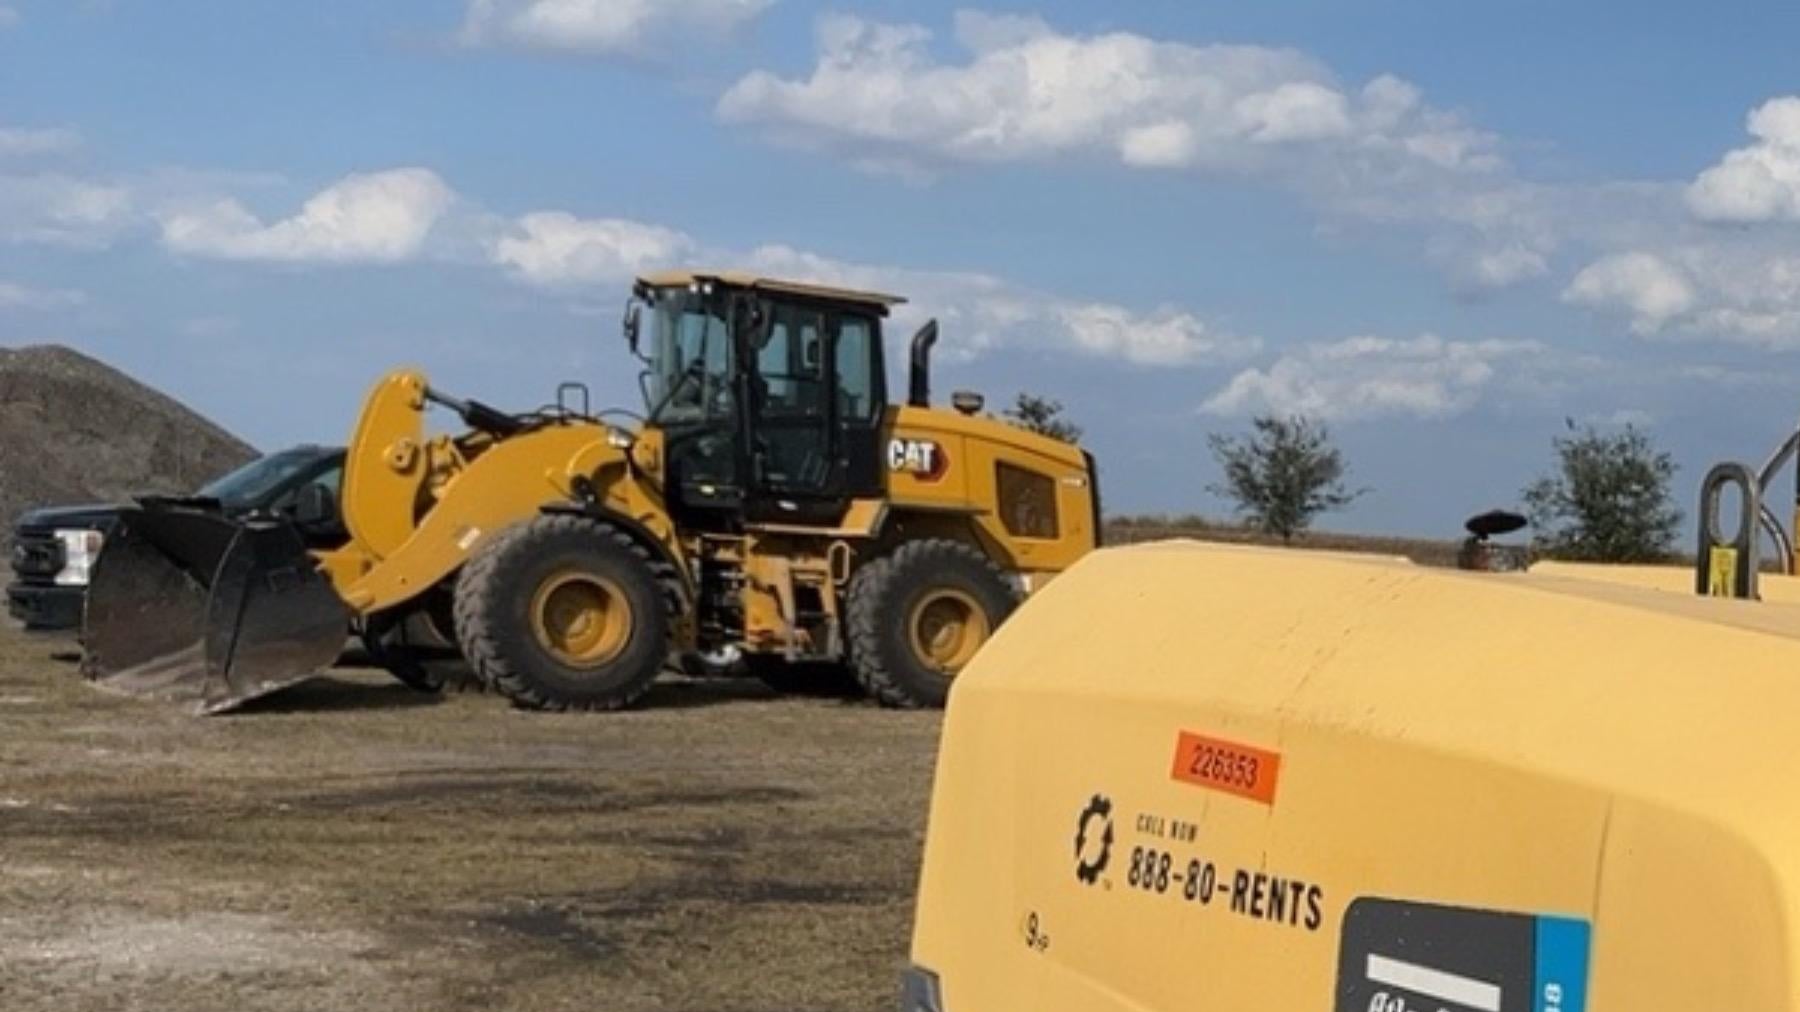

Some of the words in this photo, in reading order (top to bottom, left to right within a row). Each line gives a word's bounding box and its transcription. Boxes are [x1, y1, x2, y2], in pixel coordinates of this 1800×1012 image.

[888, 439, 935, 473] CAT
[1189, 743, 1259, 790] 226353
[1127, 845, 1323, 931] 888-80-RENTS
